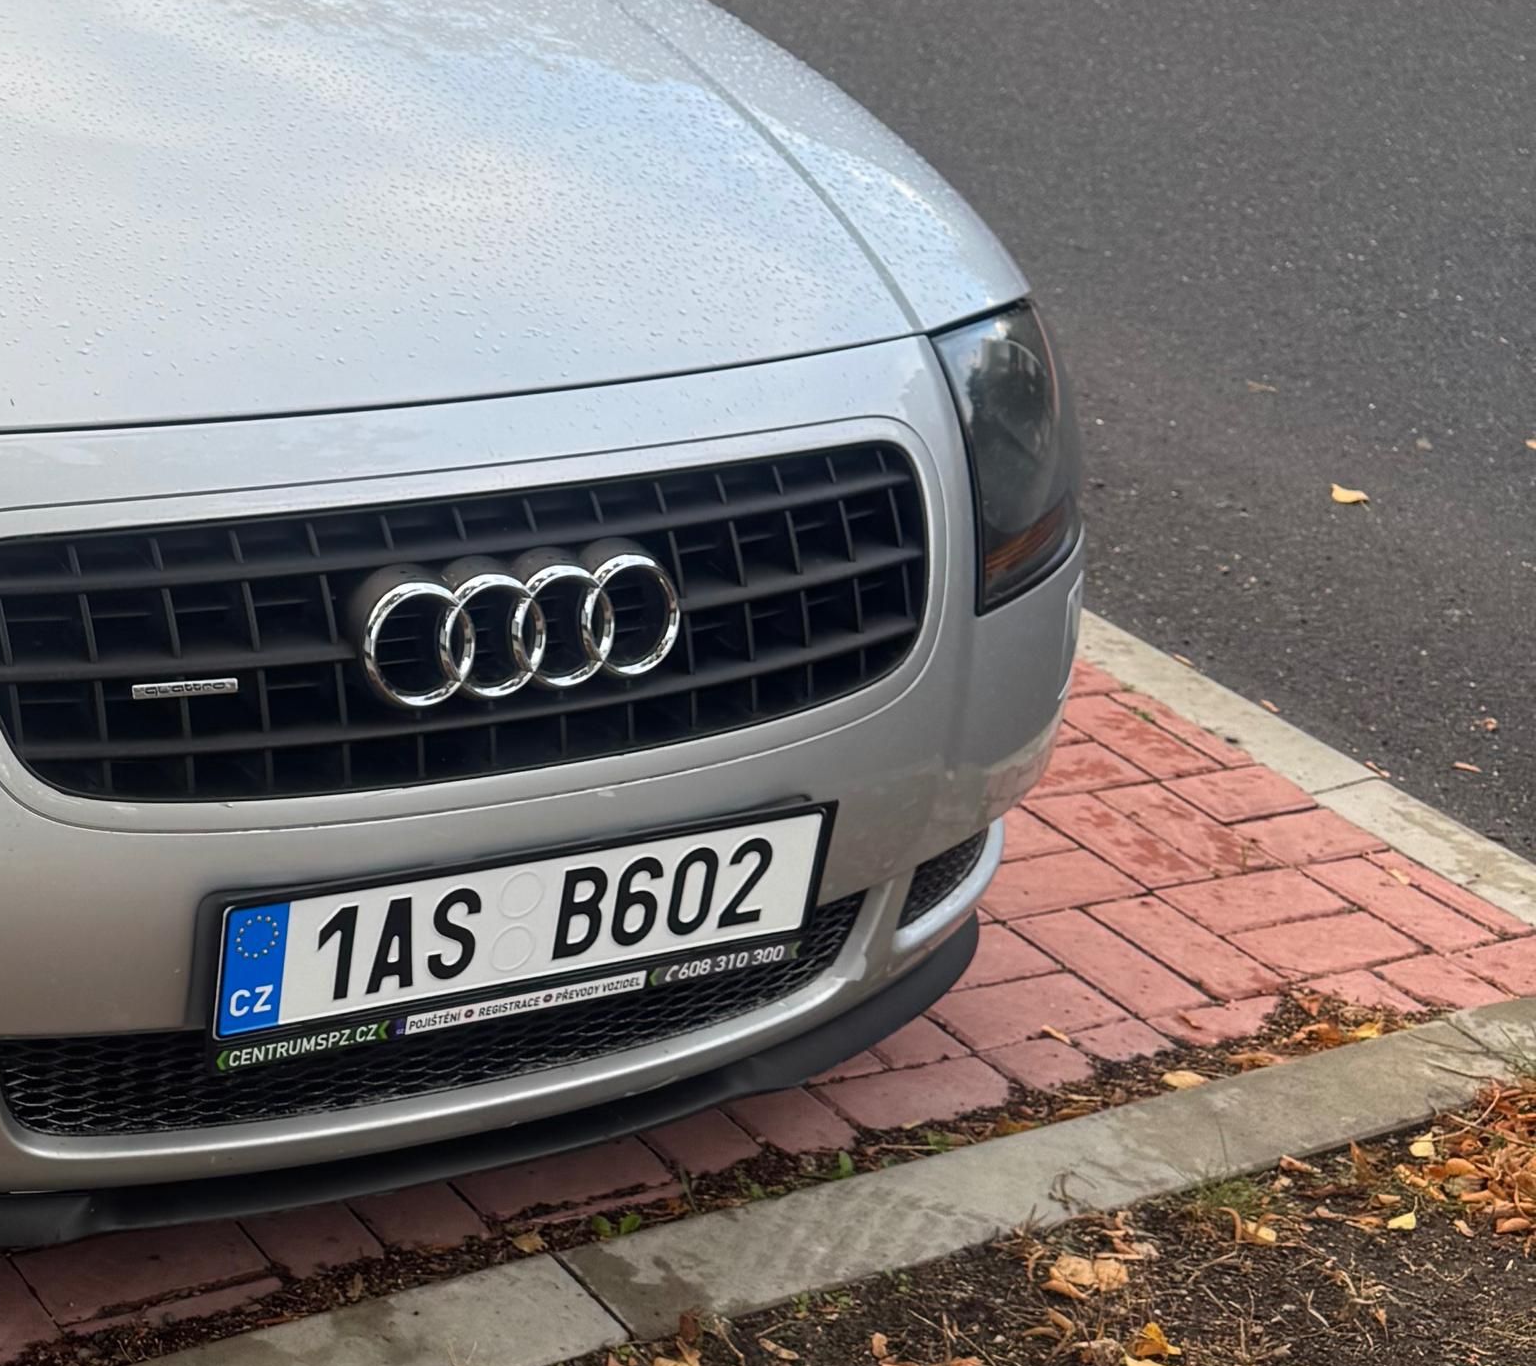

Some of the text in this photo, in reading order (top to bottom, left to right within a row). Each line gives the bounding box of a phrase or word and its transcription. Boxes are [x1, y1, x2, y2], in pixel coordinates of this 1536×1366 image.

[145, 682, 226, 696] quattro
[318, 837, 774, 1001] 1AS B602
[678, 945, 785, 980] 608 310 300
[229, 984, 274, 1017] CZ
[478, 996, 542, 1018] REGISTRACE
[555, 984, 600, 1003] PŘEVODY
[602, 976, 641, 993] VOZIDEL
[228, 1023, 379, 1067] CENTRUMSPZ.CZ
